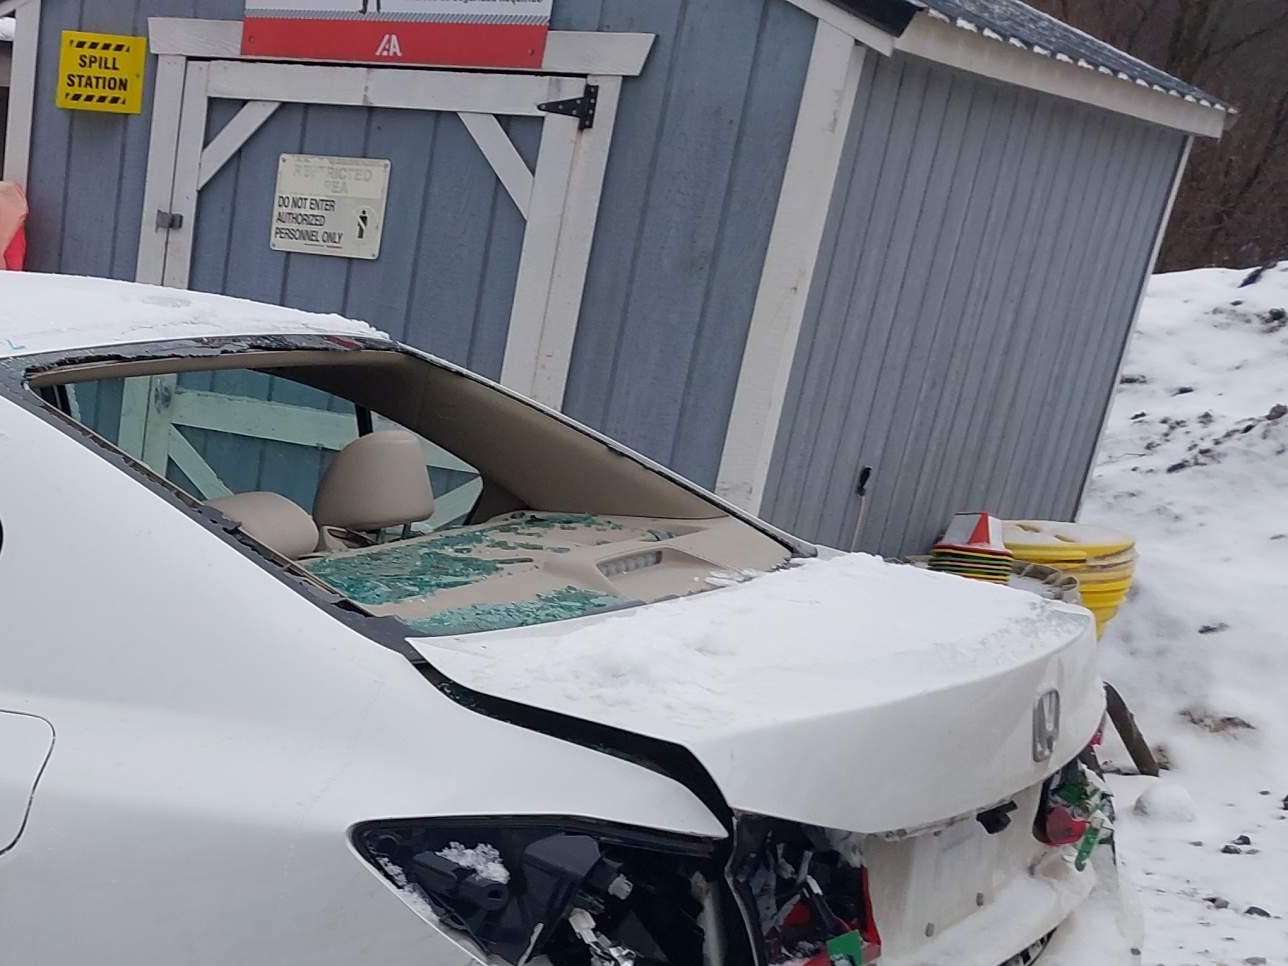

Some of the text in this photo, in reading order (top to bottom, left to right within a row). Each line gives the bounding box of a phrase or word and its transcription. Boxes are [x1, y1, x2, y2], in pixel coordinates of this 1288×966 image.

[78, 54, 120, 71] SPILL
[66, 73, 128, 92] STATION
[278, 195, 336, 212] DO NOT ENTER
[276, 211, 326, 227] AUTHORIZED
[274, 226, 343, 244] PERSONNEL ONLY
